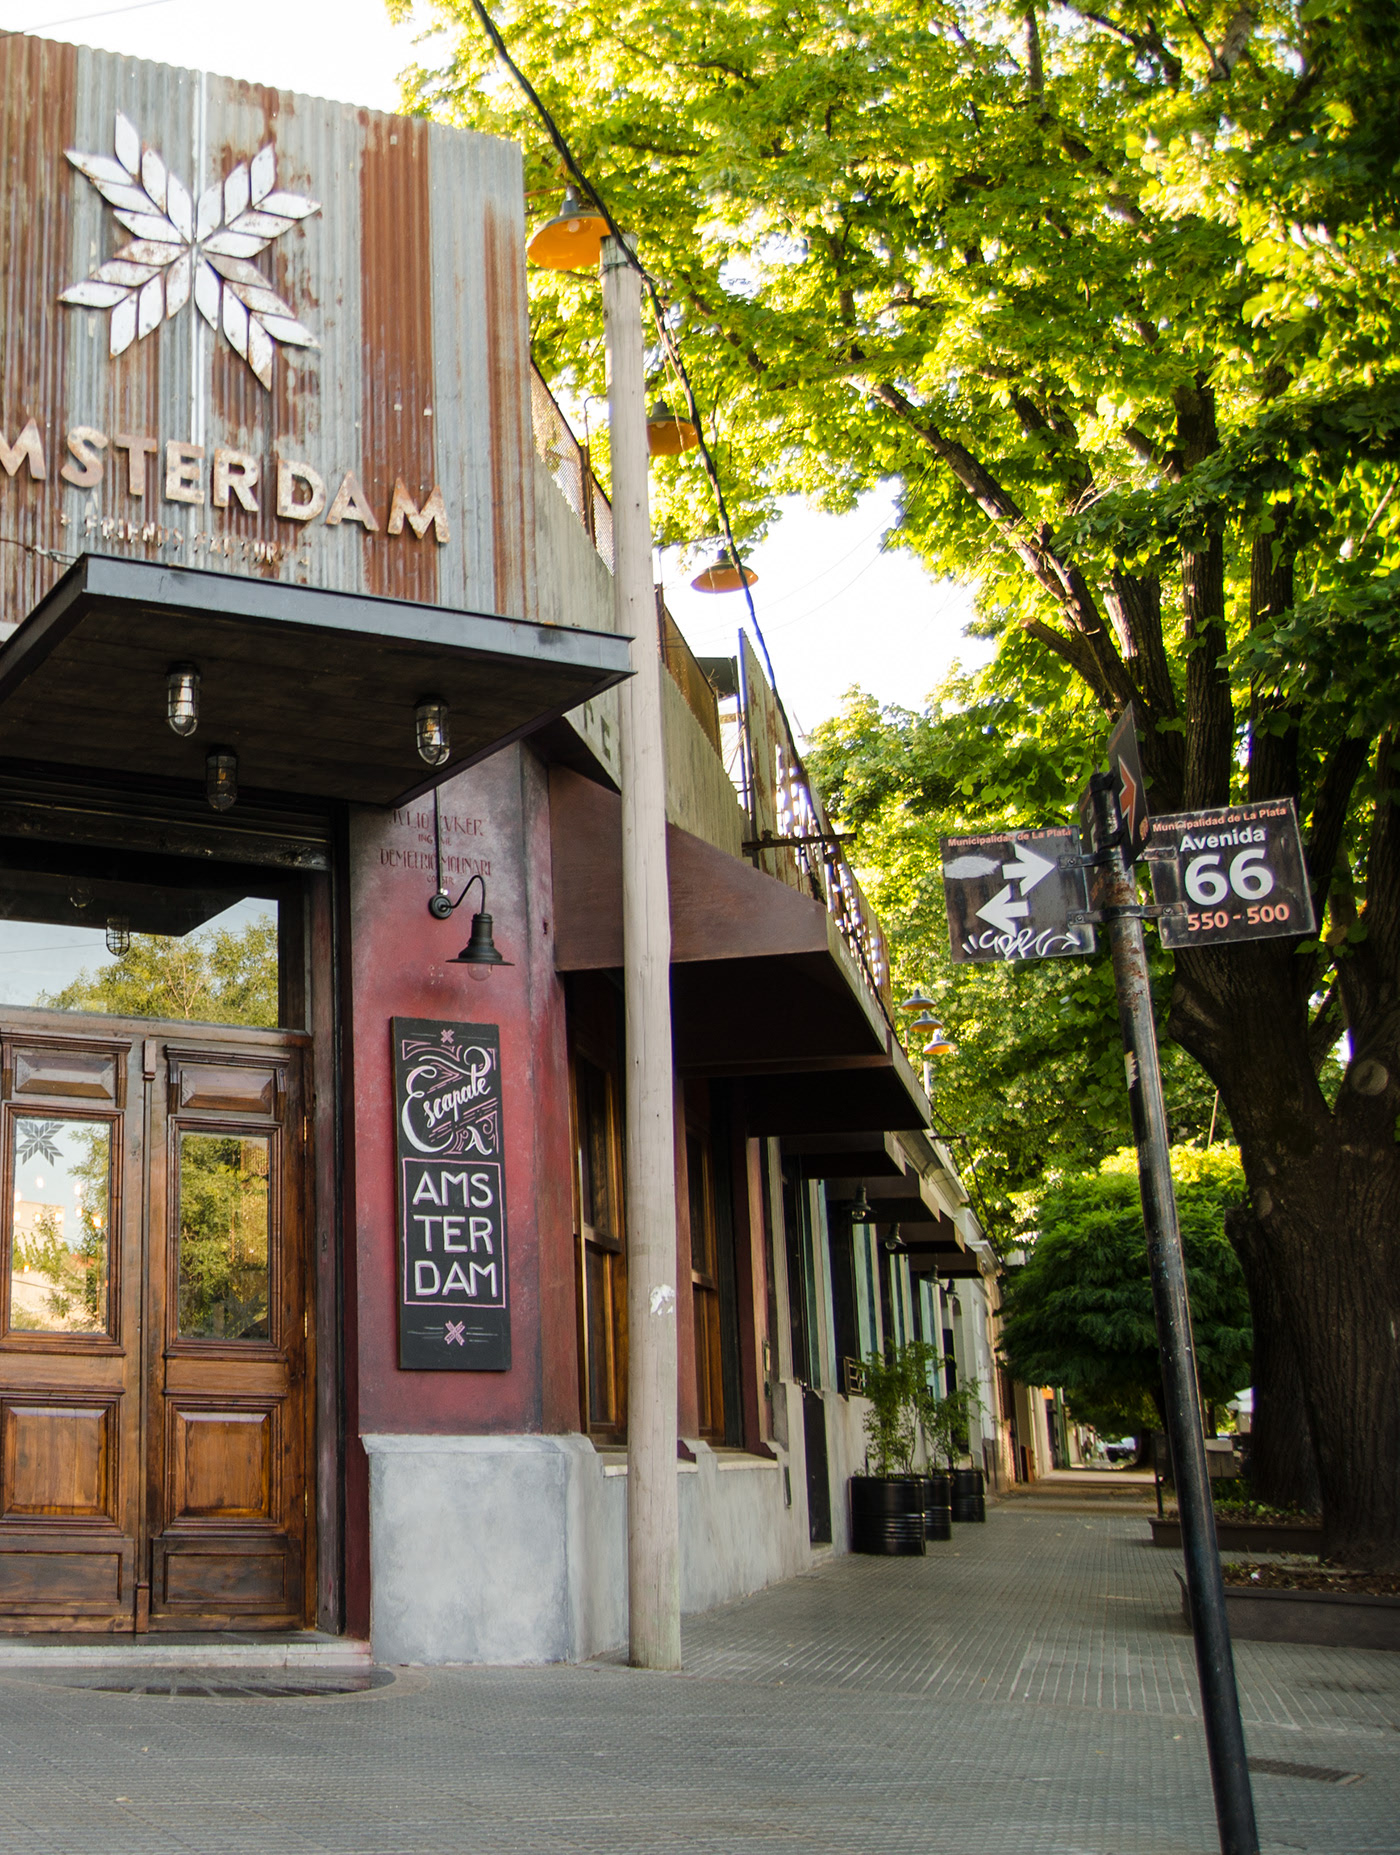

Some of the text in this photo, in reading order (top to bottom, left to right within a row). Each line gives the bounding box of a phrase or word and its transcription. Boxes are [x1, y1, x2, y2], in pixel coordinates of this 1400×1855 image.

[1227, 813, 1241, 823] de
[1243, 812, 1257, 821] La
[1259, 807, 1287, 818] Plata
[947, 828, 1073, 847] Municipalidad de La Plata
[1179, 827, 1267, 852] Avenida
[1184, 848, 1274, 906] 66
[1187, 911, 1229, 931] 550
[1246, 904, 1290, 925] 500
[401, 1046, 492, 1153] Escapate
[464, 1125, 493, 1156] A
[412, 1170, 494, 1209] AMS
[413, 1214, 494, 1255] TER
[414, 1260, 498, 1297] DAM
